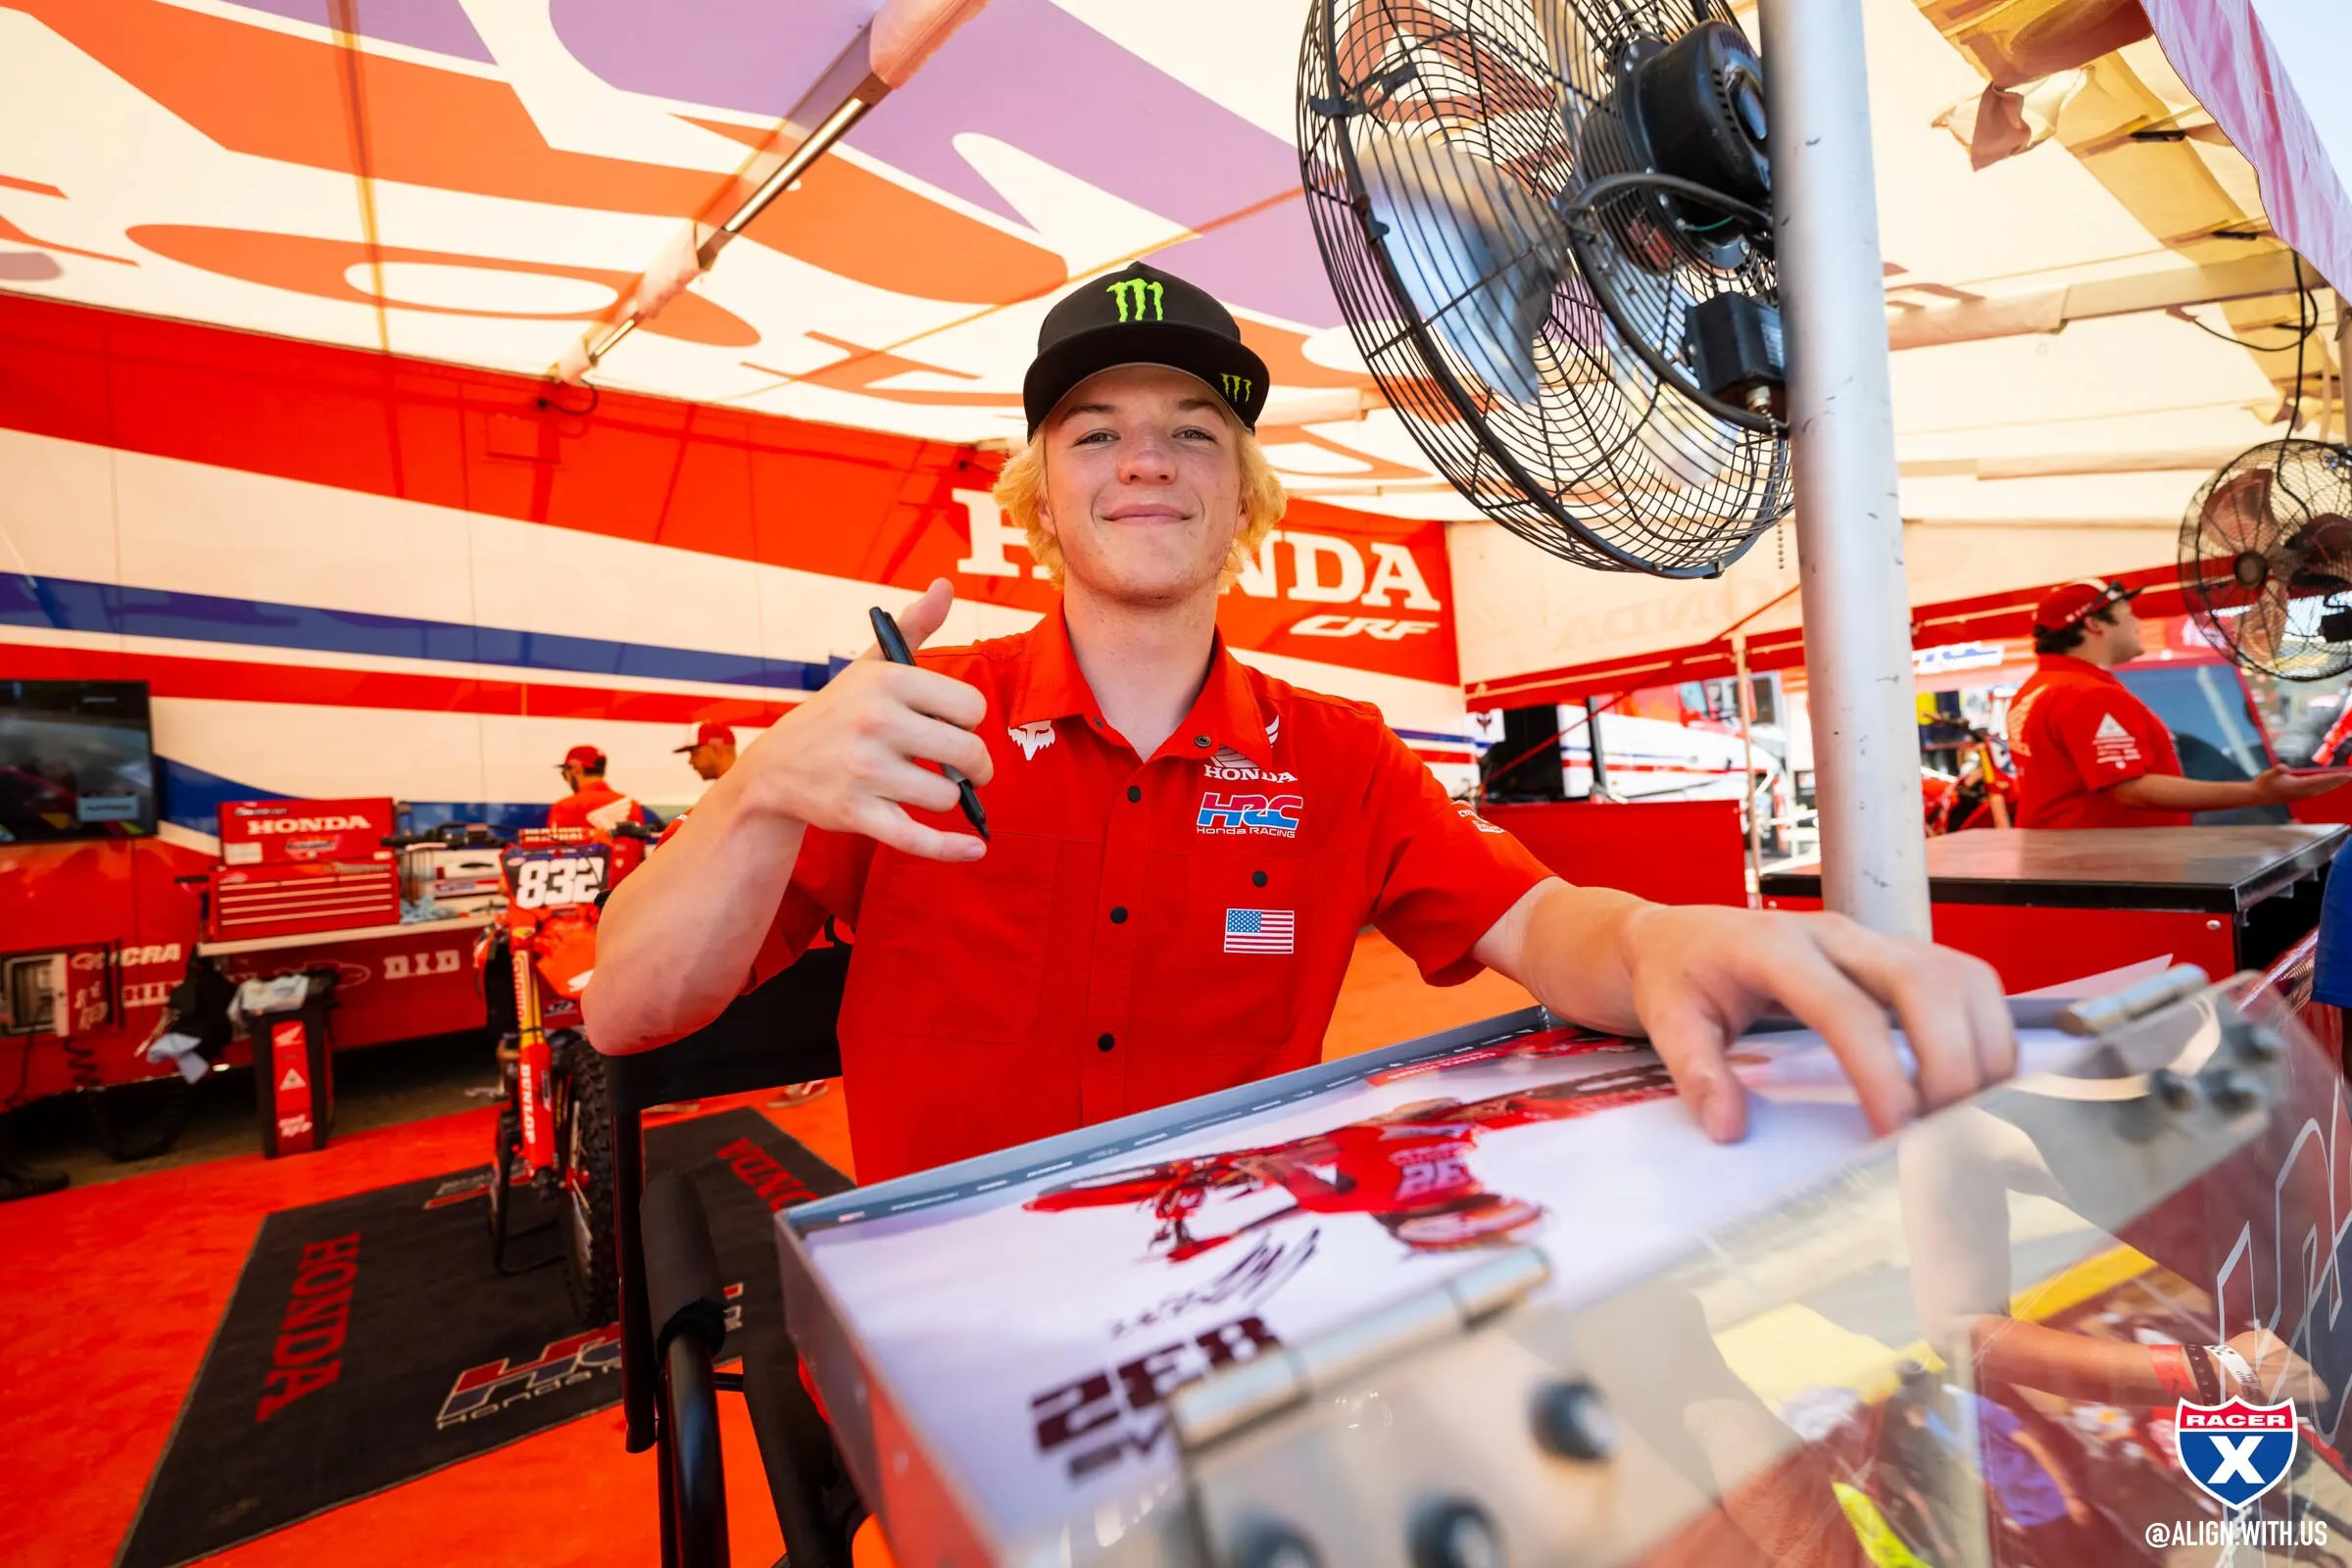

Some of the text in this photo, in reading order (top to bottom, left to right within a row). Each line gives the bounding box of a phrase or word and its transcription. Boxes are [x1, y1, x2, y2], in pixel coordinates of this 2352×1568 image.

[952, 488, 1442, 612] HNDA
[1289, 614, 1440, 640] CRF
[247, 814, 372, 835] HONDA
[1196, 791, 1303, 830] HRC
[1197, 826, 1297, 839] Honda RACING
[515, 857, 606, 909] 832
[520, 1063, 536, 1145] DUNLOP
[255, 1231, 362, 1424] HONDA
